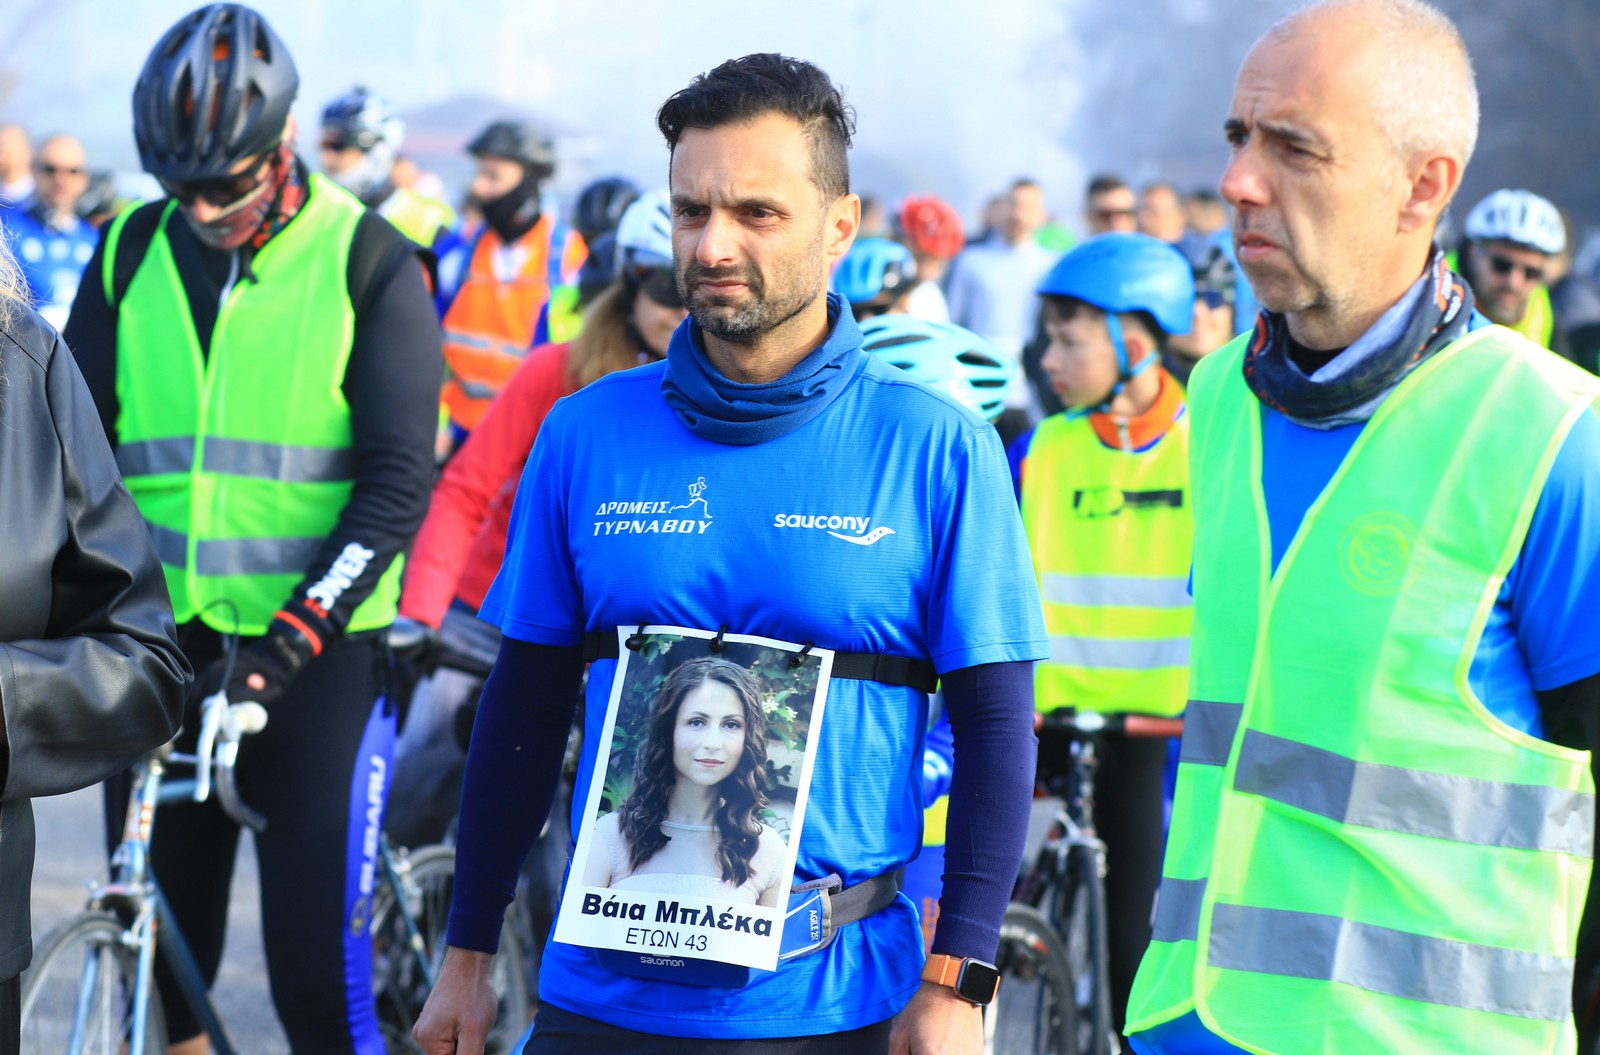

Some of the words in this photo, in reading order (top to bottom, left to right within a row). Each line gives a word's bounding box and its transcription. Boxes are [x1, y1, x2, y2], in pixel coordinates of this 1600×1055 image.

[595, 501, 670, 516] ΔΡΟΜΕΙΣ
[592, 519, 713, 537] ΤΥΡΝΑΒΟΥ
[773, 513, 871, 535] saucony
[359, 755, 386, 895] SUBARU
[581, 893, 647, 921] Βάια
[654, 900, 773, 937] Μπλέκα
[625, 927, 679, 949] ΕΤΩΝ
[684, 933, 708, 952] 43
[640, 956, 685, 967] salomon
